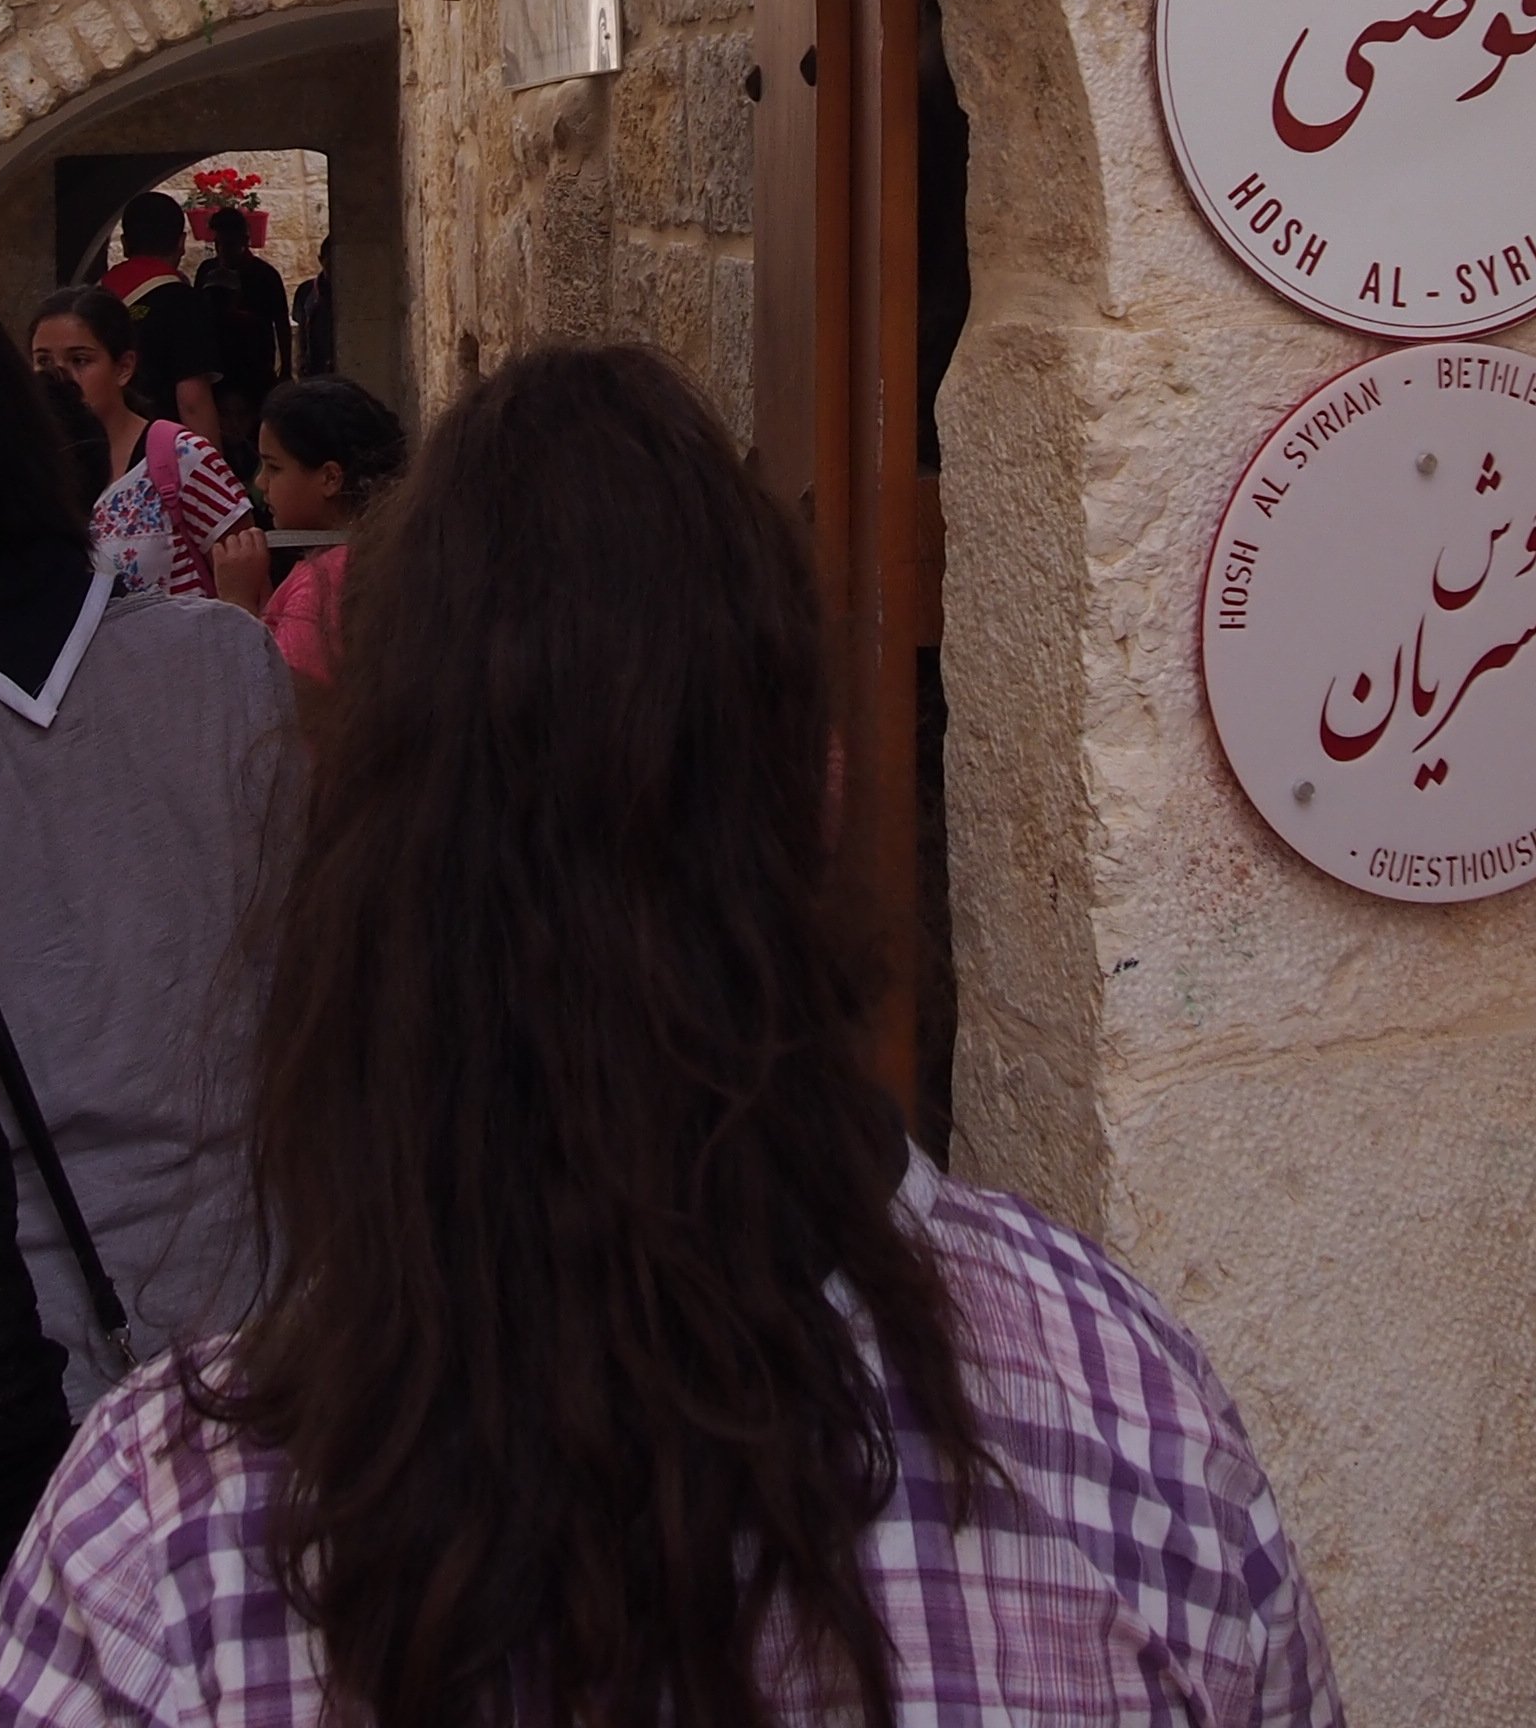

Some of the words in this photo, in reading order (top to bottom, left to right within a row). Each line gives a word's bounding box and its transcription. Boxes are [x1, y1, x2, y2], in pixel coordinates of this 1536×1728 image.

[1227, 172, 1328, 276] HOSH
[1219, 539, 1260, 631] HOSH
[1252, 477, 1290, 519] AL
[1283, 377, 1382, 470] SYRIAN
